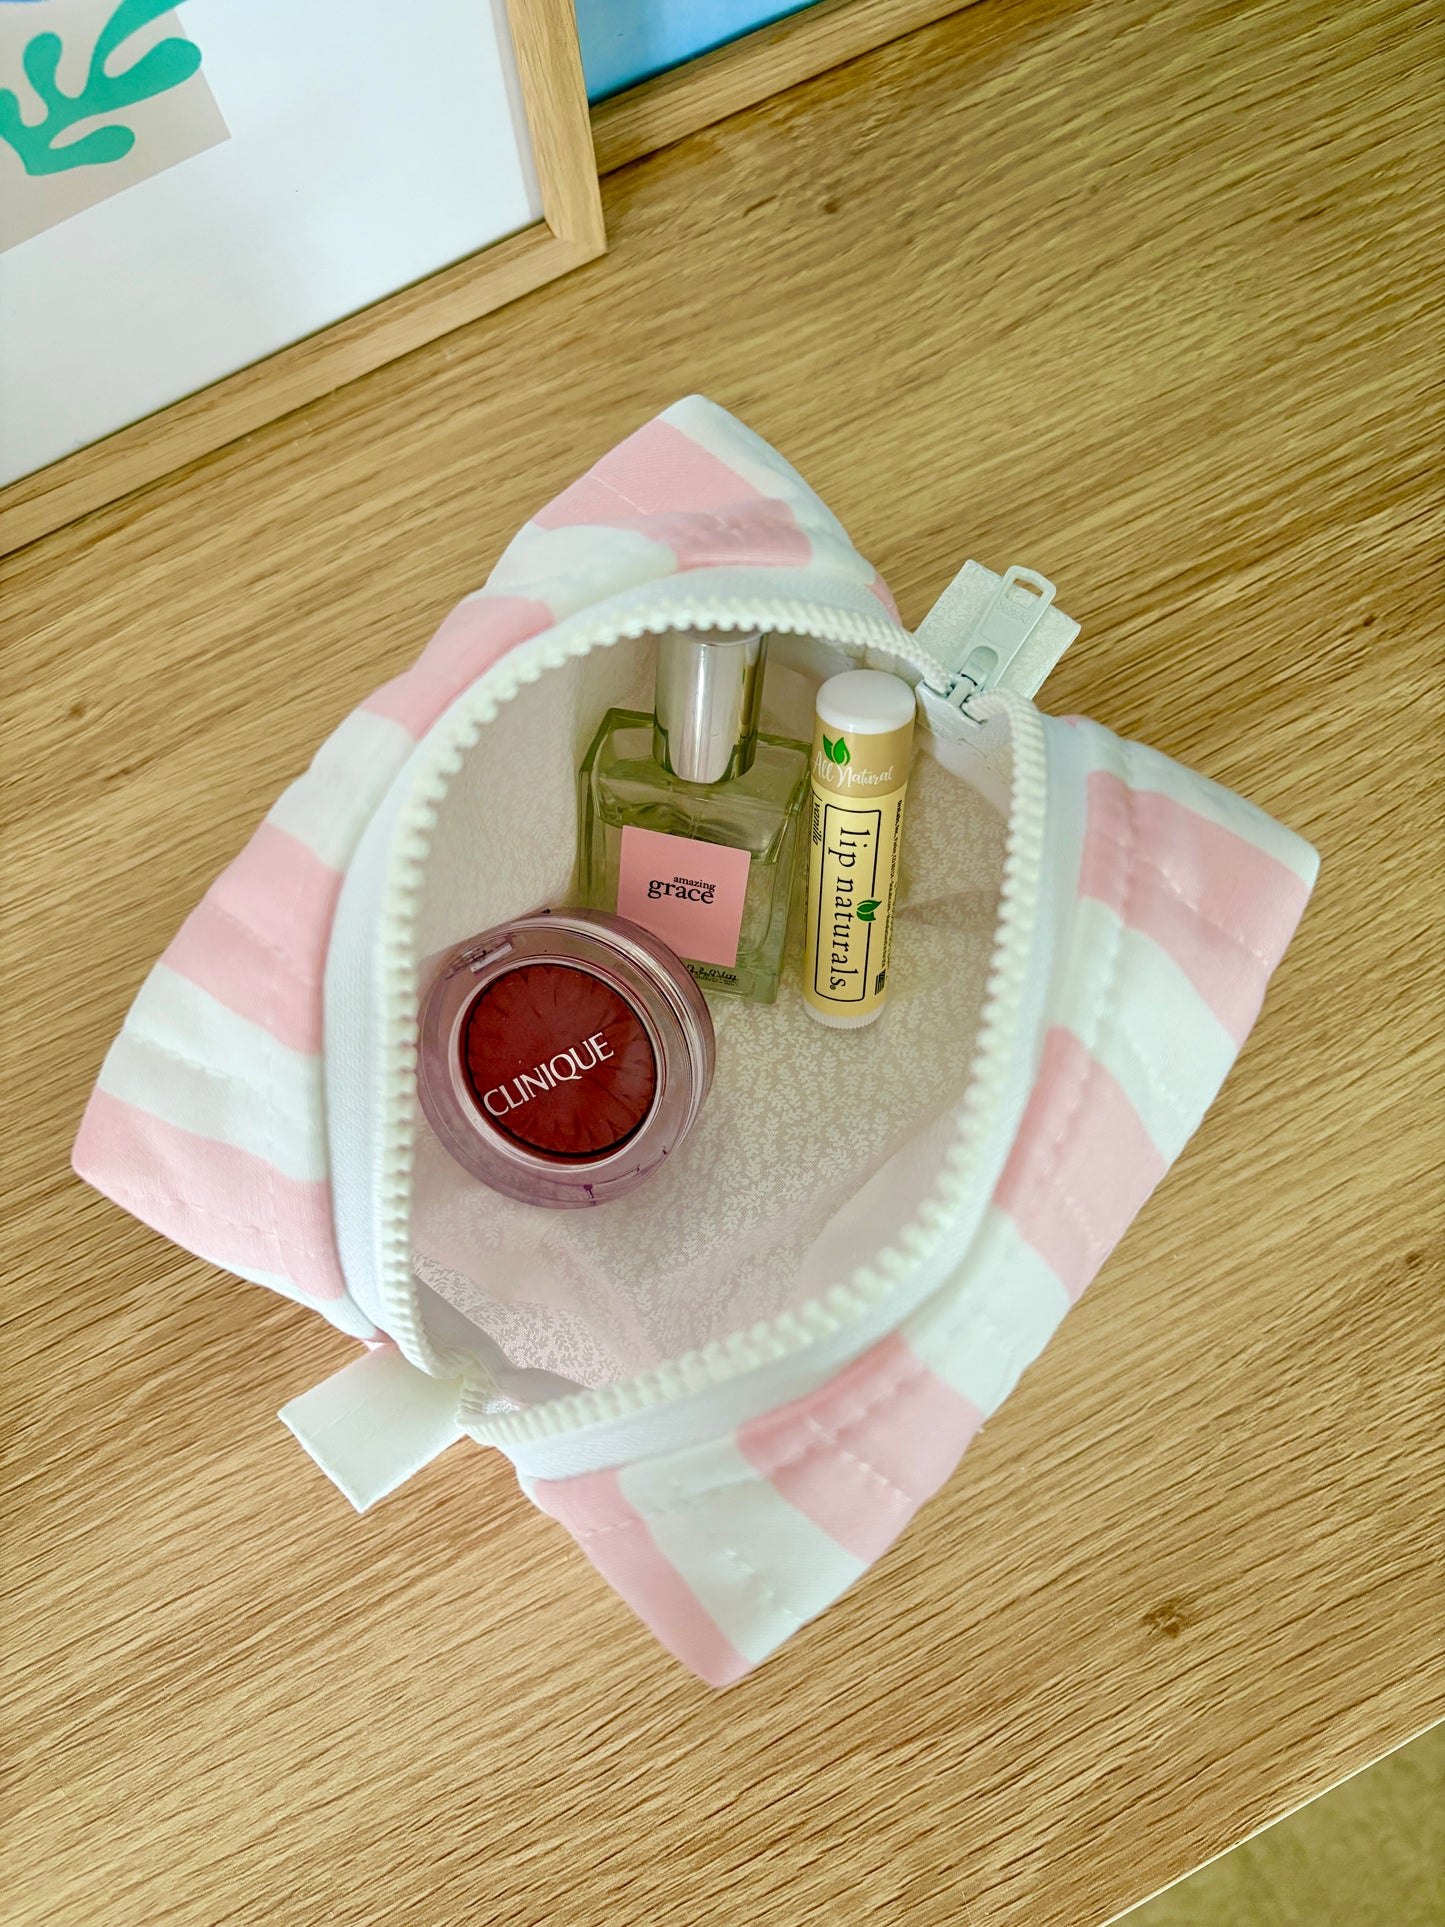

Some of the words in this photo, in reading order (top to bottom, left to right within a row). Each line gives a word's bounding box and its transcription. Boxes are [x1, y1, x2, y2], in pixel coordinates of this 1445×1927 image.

[813, 750, 834, 782] All
[836, 764, 895, 788] Natural
[812, 801, 823, 846] vanilla
[828, 826, 871, 869] lip
[647, 879, 715, 905] grace
[673, 876, 716, 893] amazing
[829, 876, 859, 989] naturals
[482, 1031, 615, 1117] CLINIQUE
